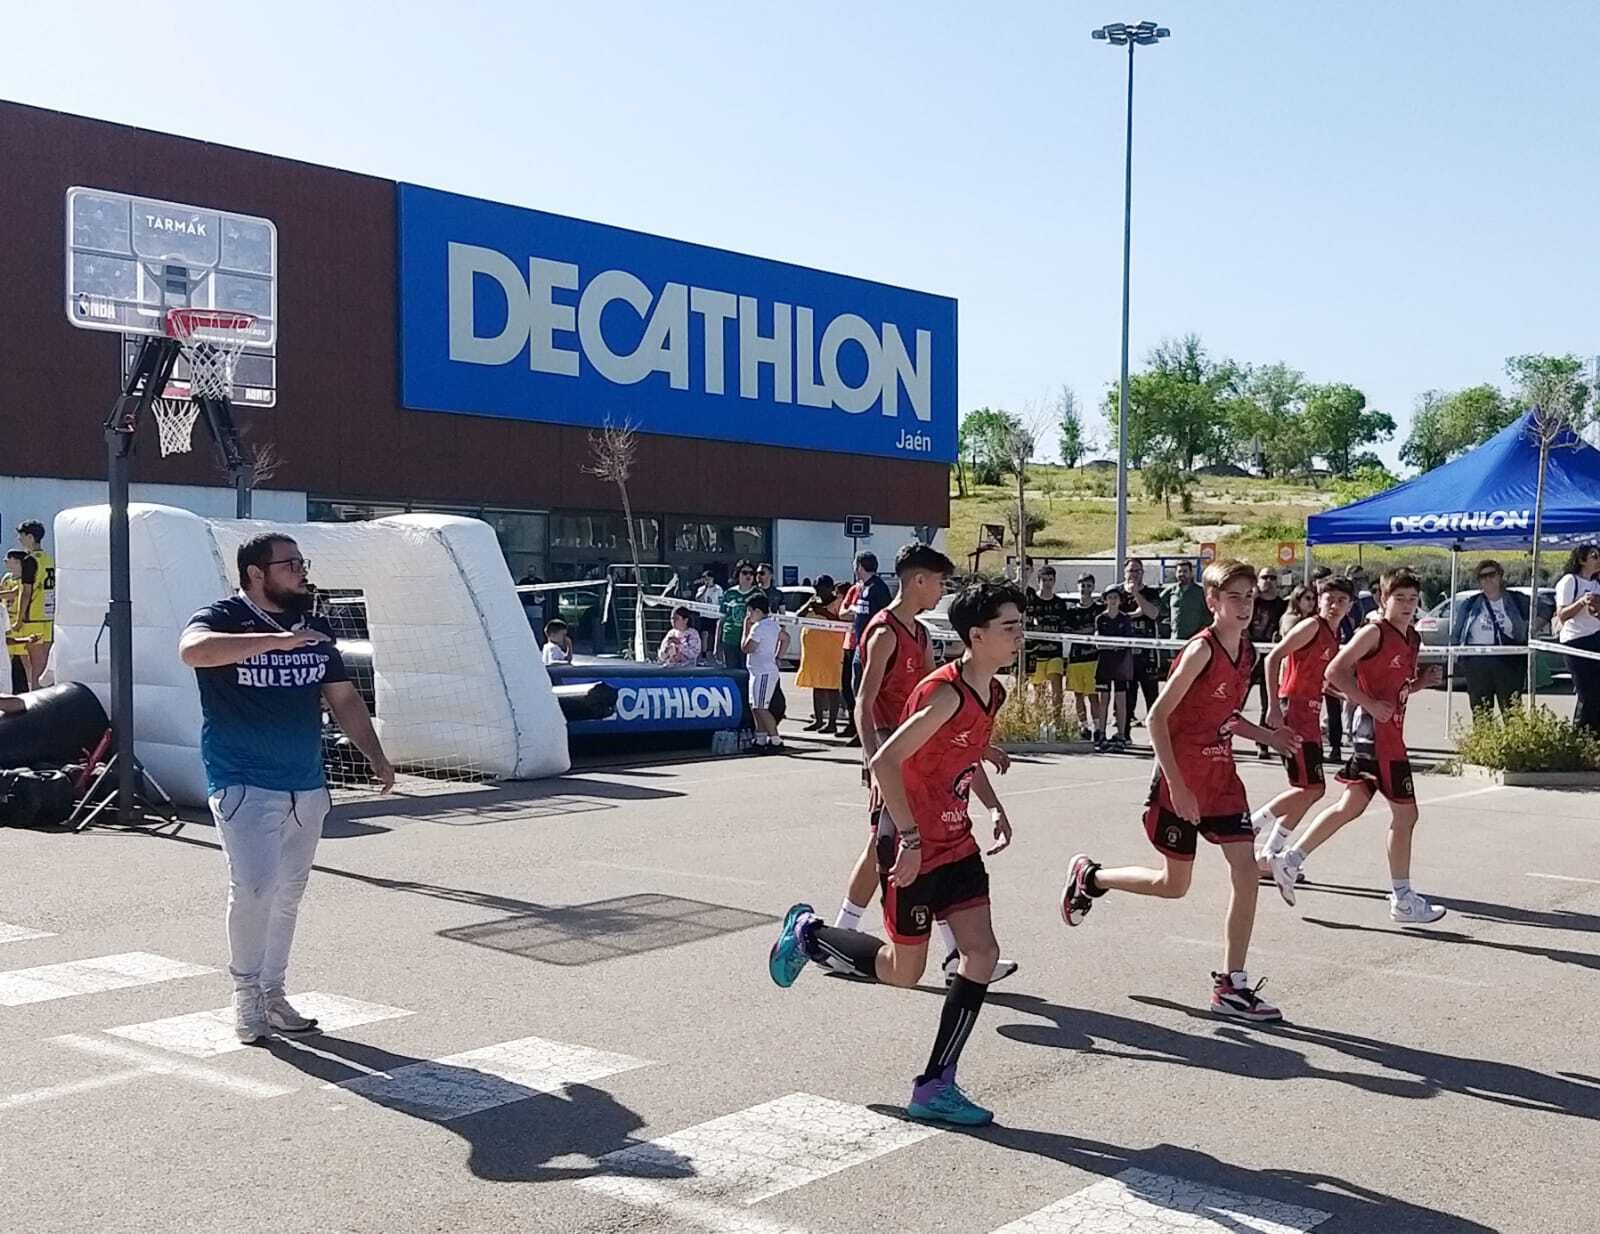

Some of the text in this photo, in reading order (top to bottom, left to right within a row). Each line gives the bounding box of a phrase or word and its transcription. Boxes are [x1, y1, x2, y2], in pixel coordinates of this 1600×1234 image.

[146, 214, 207, 237] TARMÁK
[90, 301, 117, 319] NBA
[447, 241, 932, 422] DECATHLON
[895, 429, 932, 453] Jaén
[1390, 510, 1530, 535] DECATHLON
[240, 654, 268, 665] LUB
[602, 687, 733, 721] CATHLON
